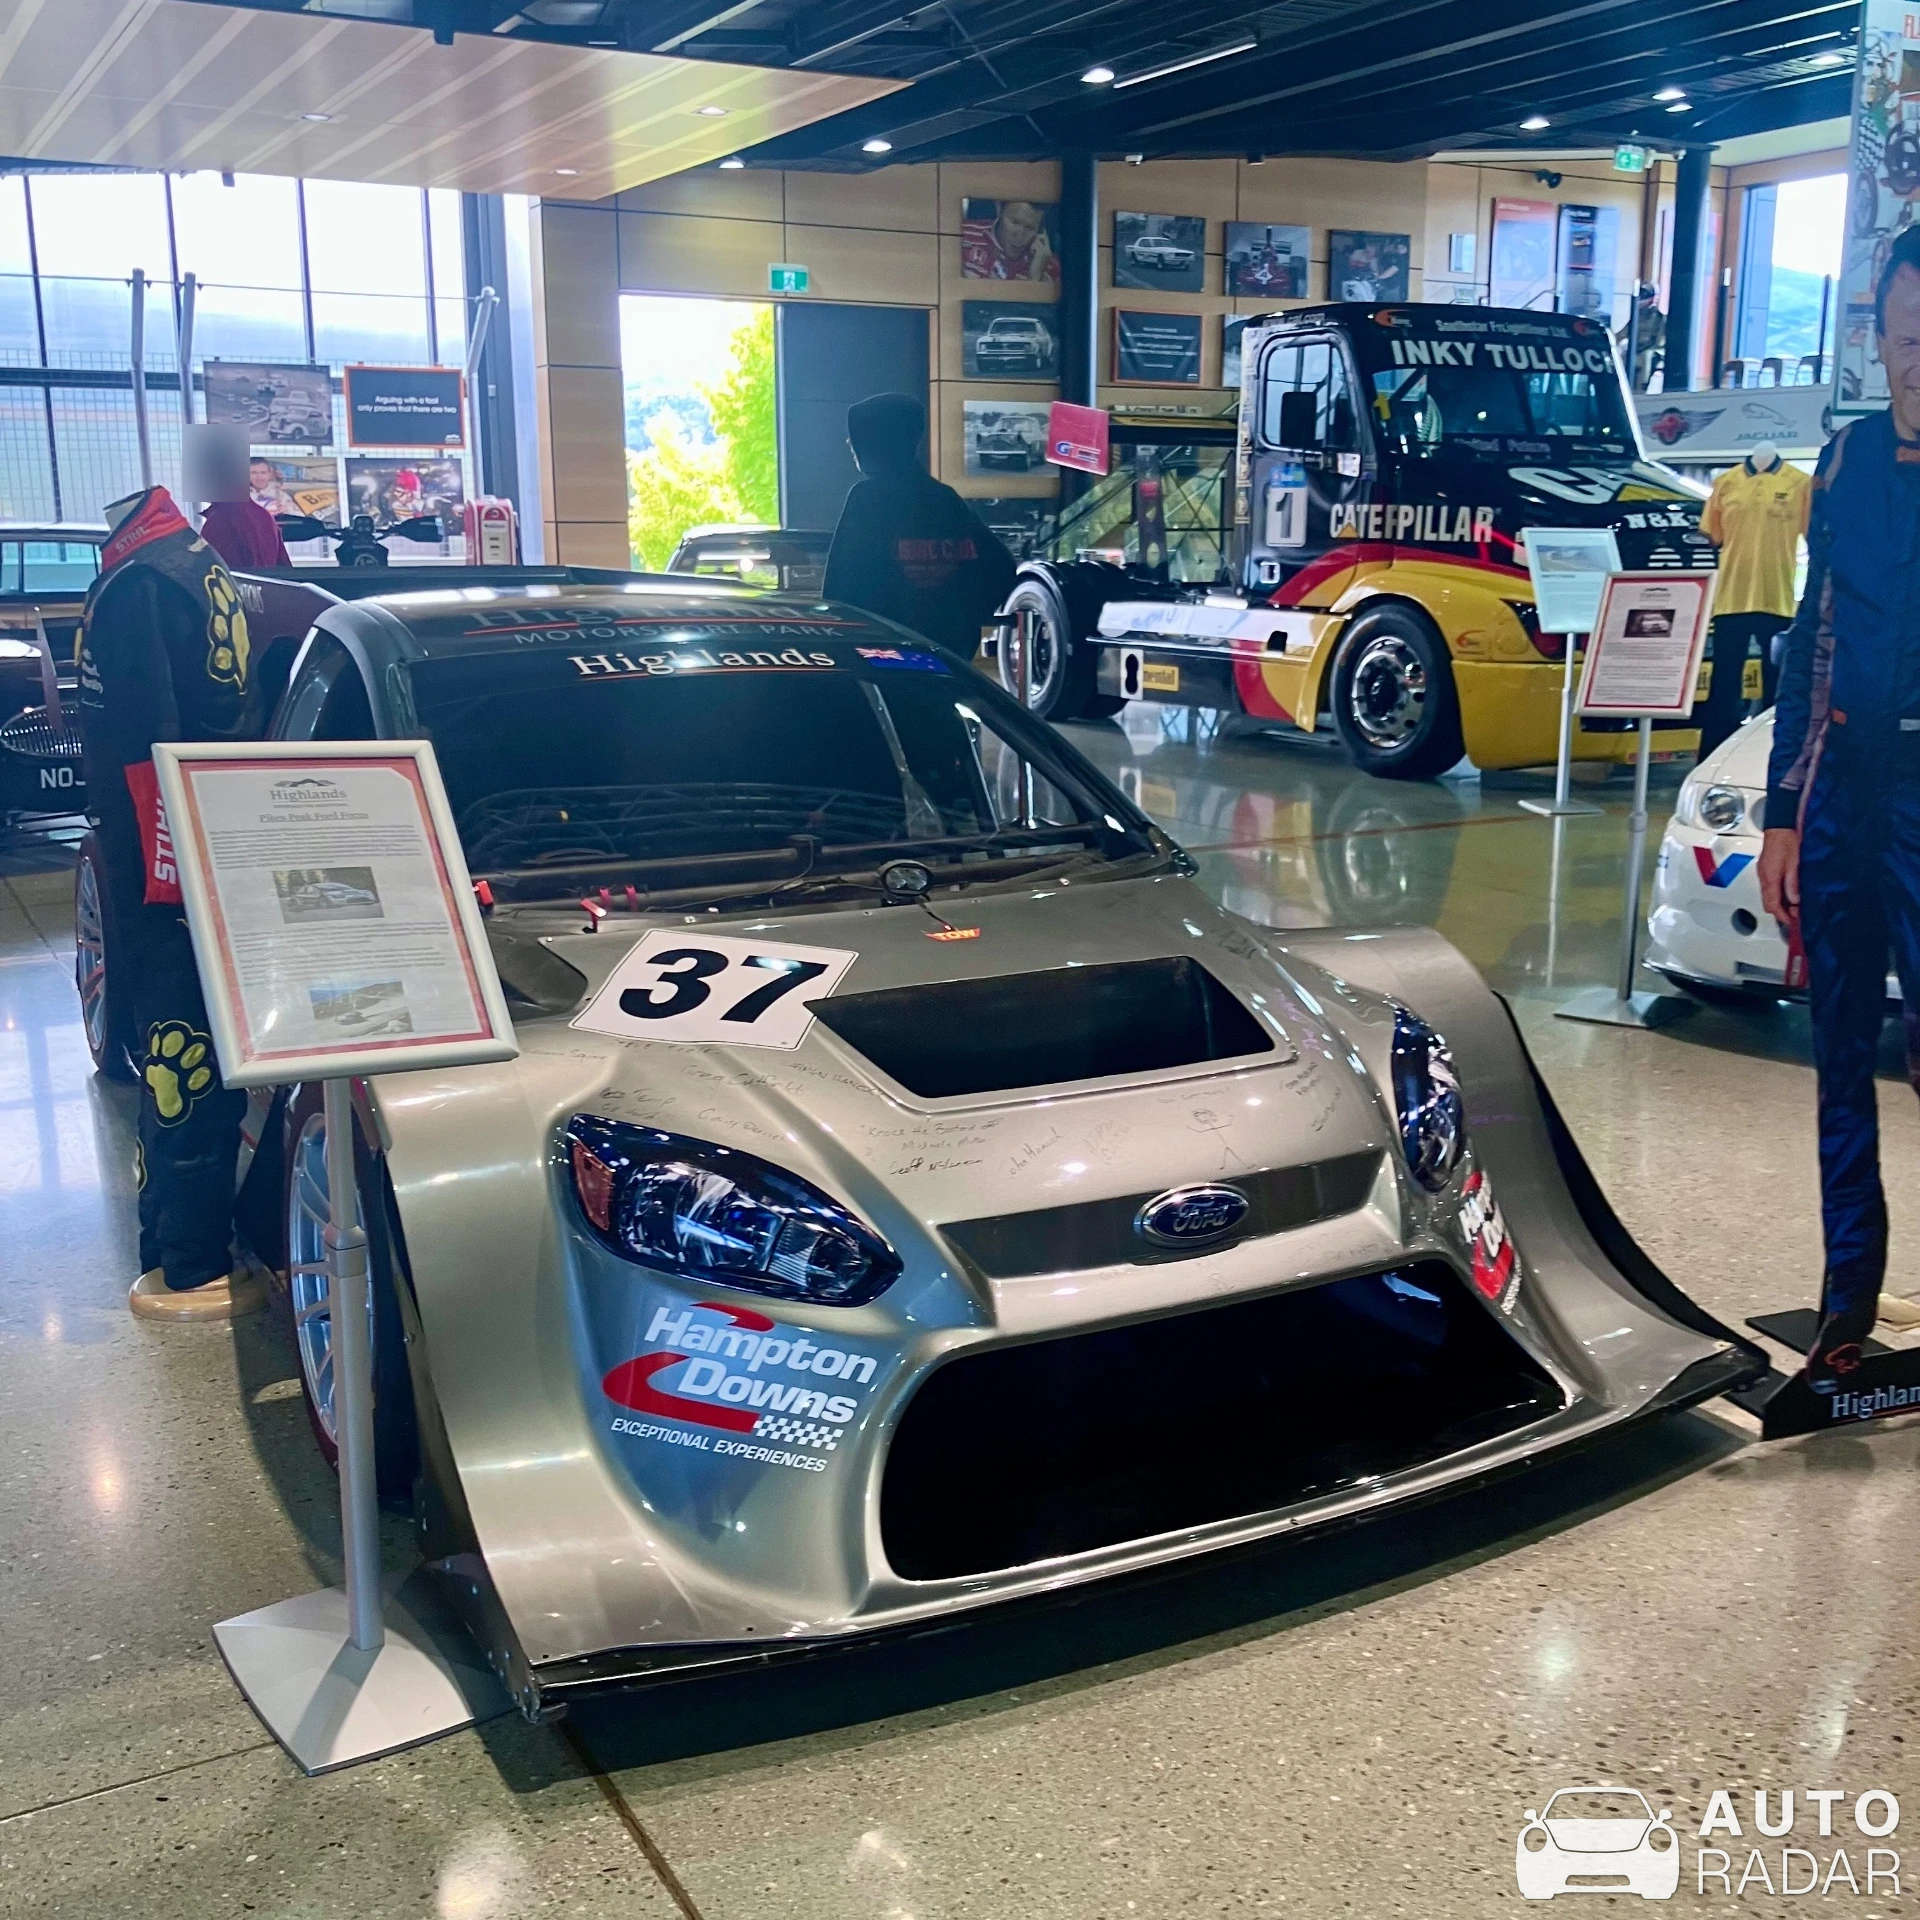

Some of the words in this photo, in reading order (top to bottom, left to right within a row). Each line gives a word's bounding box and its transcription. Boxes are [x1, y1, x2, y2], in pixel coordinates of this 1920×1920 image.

[1391, 340, 1476, 366] INKY
[1275, 492, 1294, 539] 1
[115, 525, 147, 553] STIHL
[514, 624, 740, 645] MOTORSPORT
[760, 624, 844, 638] PARK
[566, 647, 836, 676] Highlands
[269, 789, 348, 803] Highlands
[618, 947, 830, 1024] 37
[1173, 1200, 1230, 1231] Ford
[643, 1305, 878, 1385] Hampton
[676, 1356, 859, 1424] Downs
[610, 1417, 711, 1451] EXCEPTIONAL
[712, 1439, 828, 1473] EXPERIENCES
